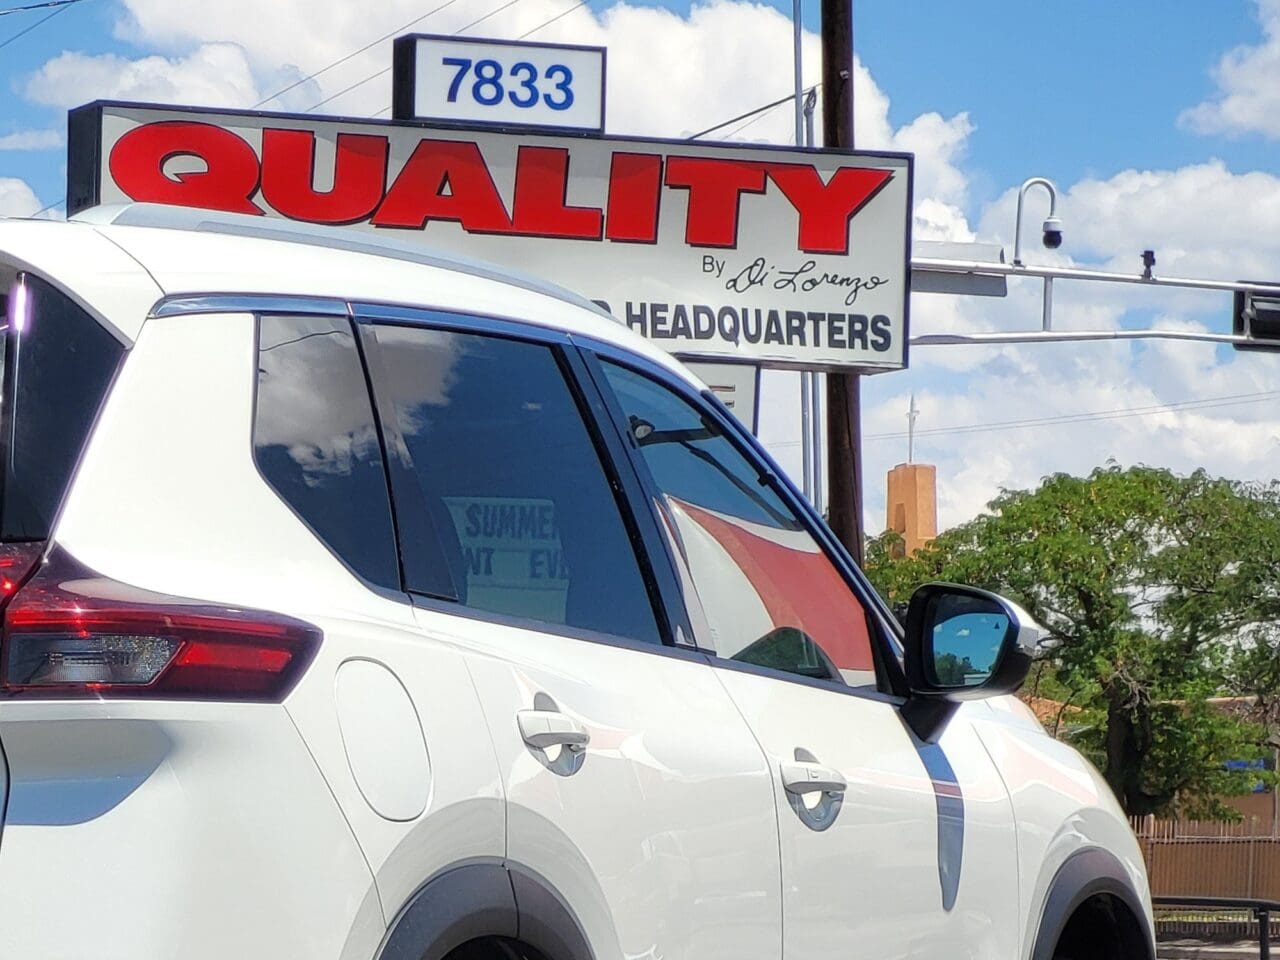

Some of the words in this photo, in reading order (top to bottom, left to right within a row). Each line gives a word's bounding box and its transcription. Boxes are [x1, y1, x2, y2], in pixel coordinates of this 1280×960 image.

[442, 57, 576, 112] 7833
[109, 120, 895, 255] QUALITY
[702, 255, 725, 278] By
[774, 260, 889, 306] Lorenzo
[626, 301, 891, 352] HEADQUARTERS
